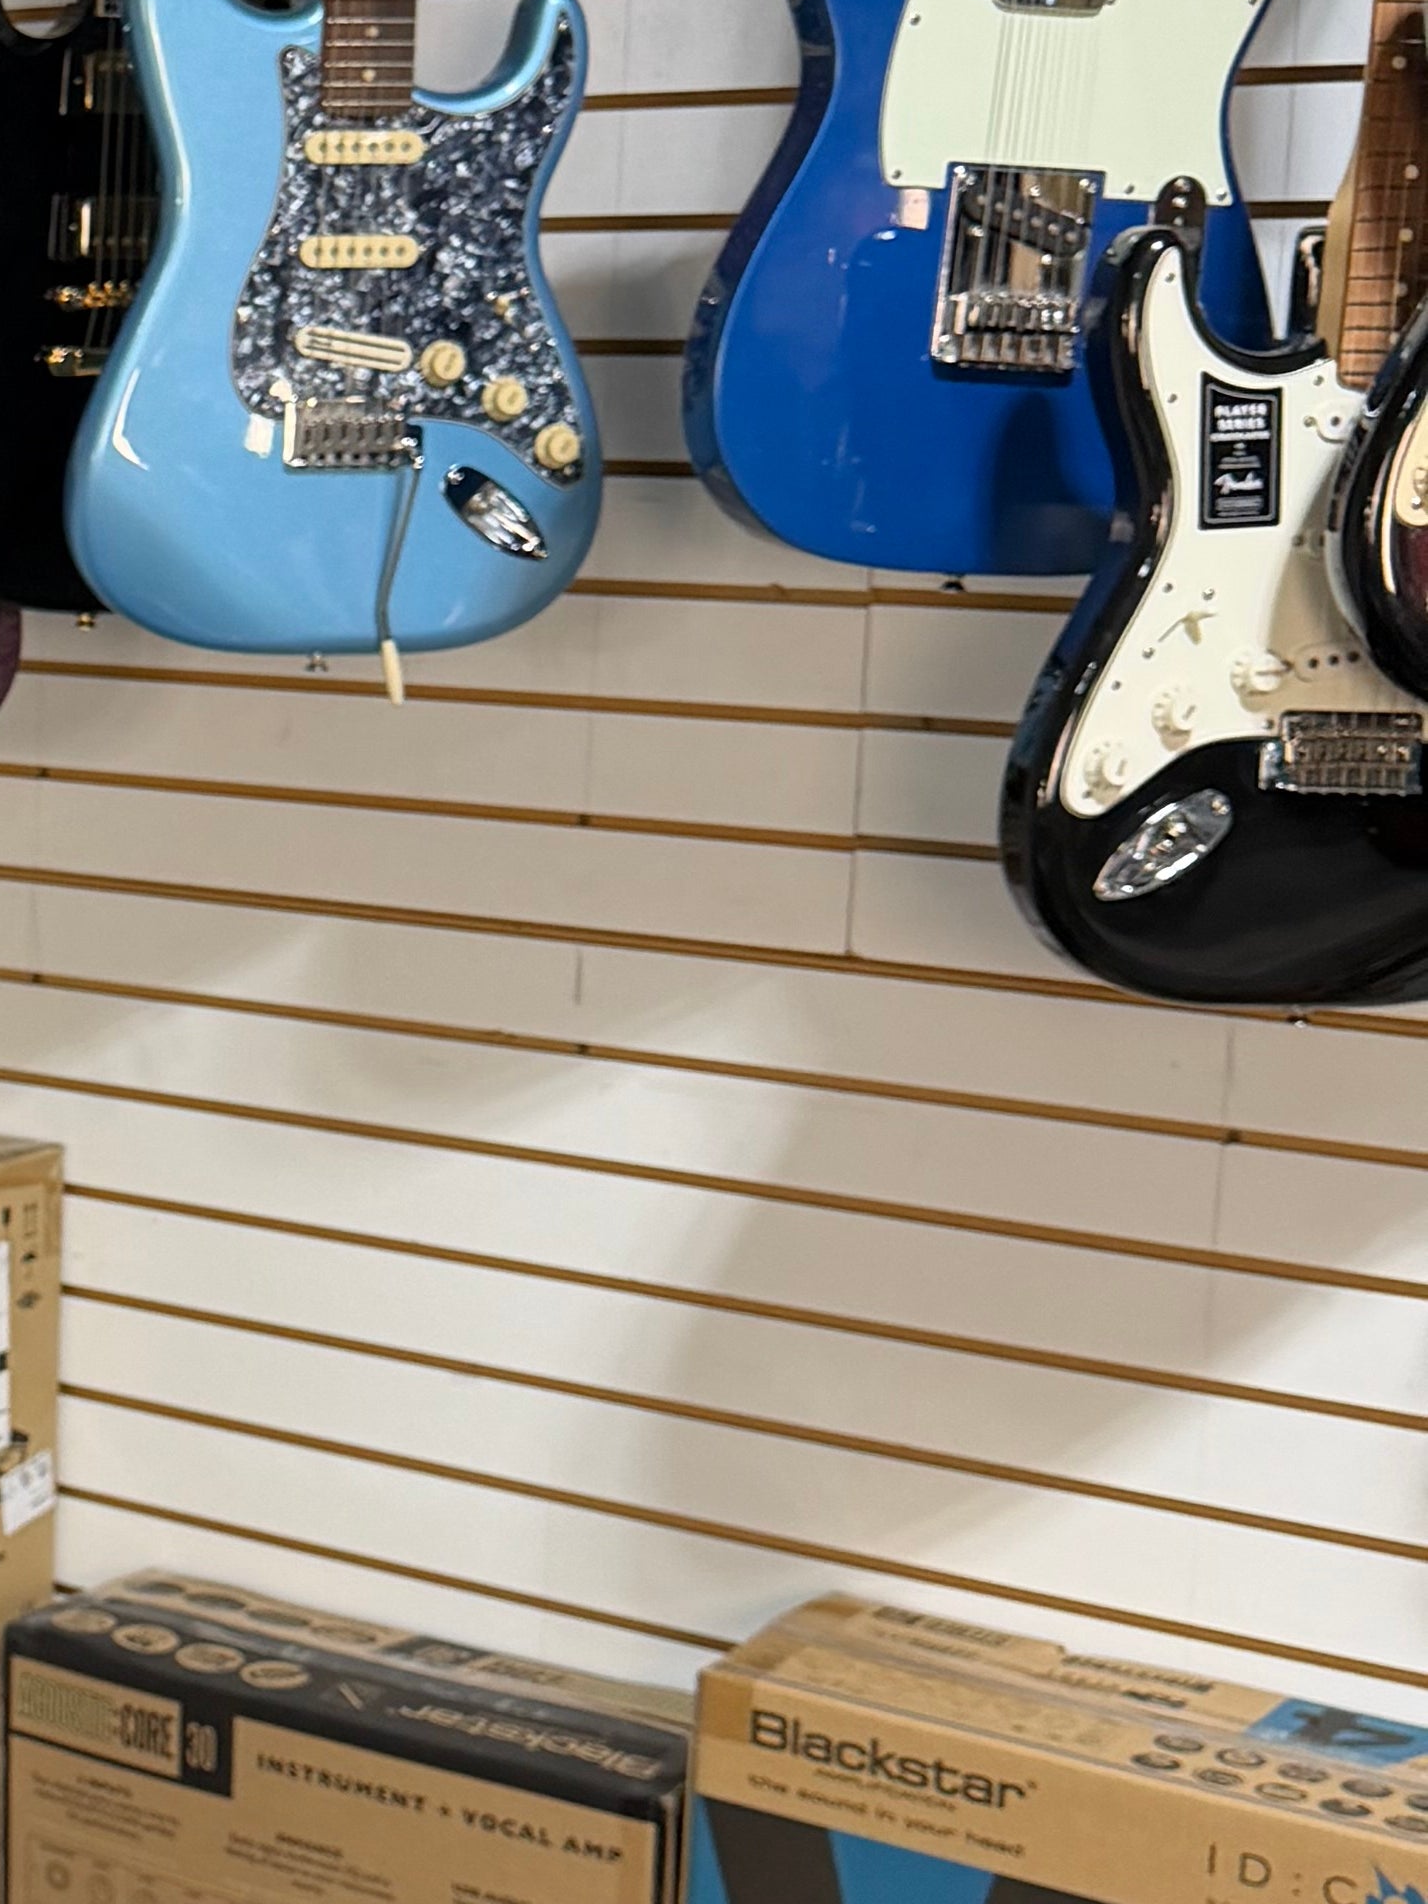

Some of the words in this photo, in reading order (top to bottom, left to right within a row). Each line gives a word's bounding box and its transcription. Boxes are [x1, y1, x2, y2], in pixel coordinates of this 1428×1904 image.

[255, 1752, 426, 1817] INSTRUMENT
[463, 1804, 552, 1850] VOCAL
[560, 1831, 625, 1866] AMP
[749, 1707, 1026, 1811] Blackstar
